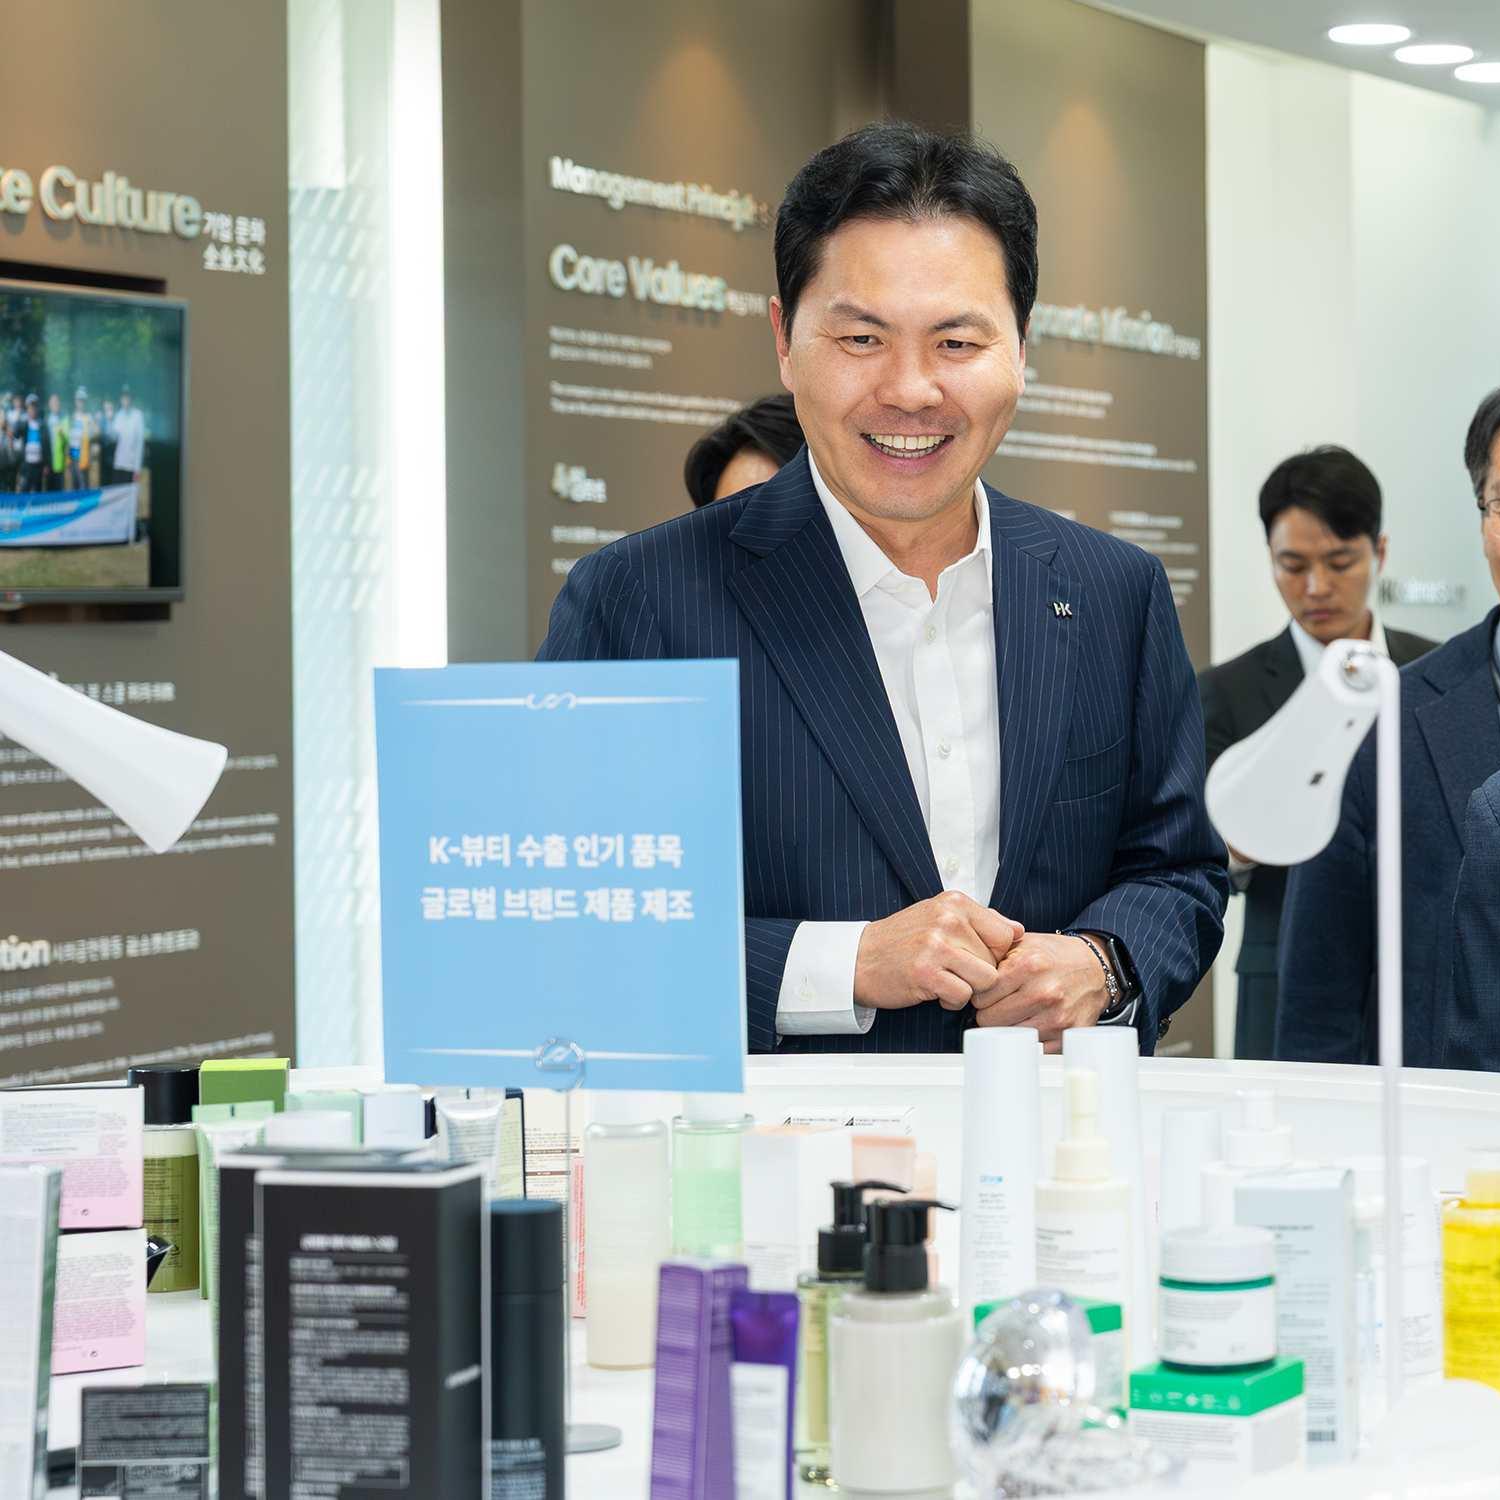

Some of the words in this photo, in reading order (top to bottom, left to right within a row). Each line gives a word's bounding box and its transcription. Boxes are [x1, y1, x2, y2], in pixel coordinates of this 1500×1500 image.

[40, 164, 202, 239] Culture
[551, 244, 627, 298] Core
[627, 255, 727, 313] Values
[428, 834, 511, 868] K-뷰티
[516, 833, 569, 868] 수출
[573, 833, 624, 868] 인기
[629, 834, 684, 868] 품목
[420, 886, 497, 921] 글로벌
[502, 887, 579, 922] 브랜드
[583, 887, 636, 922] 제품
[640, 887, 694, 922] 제조
